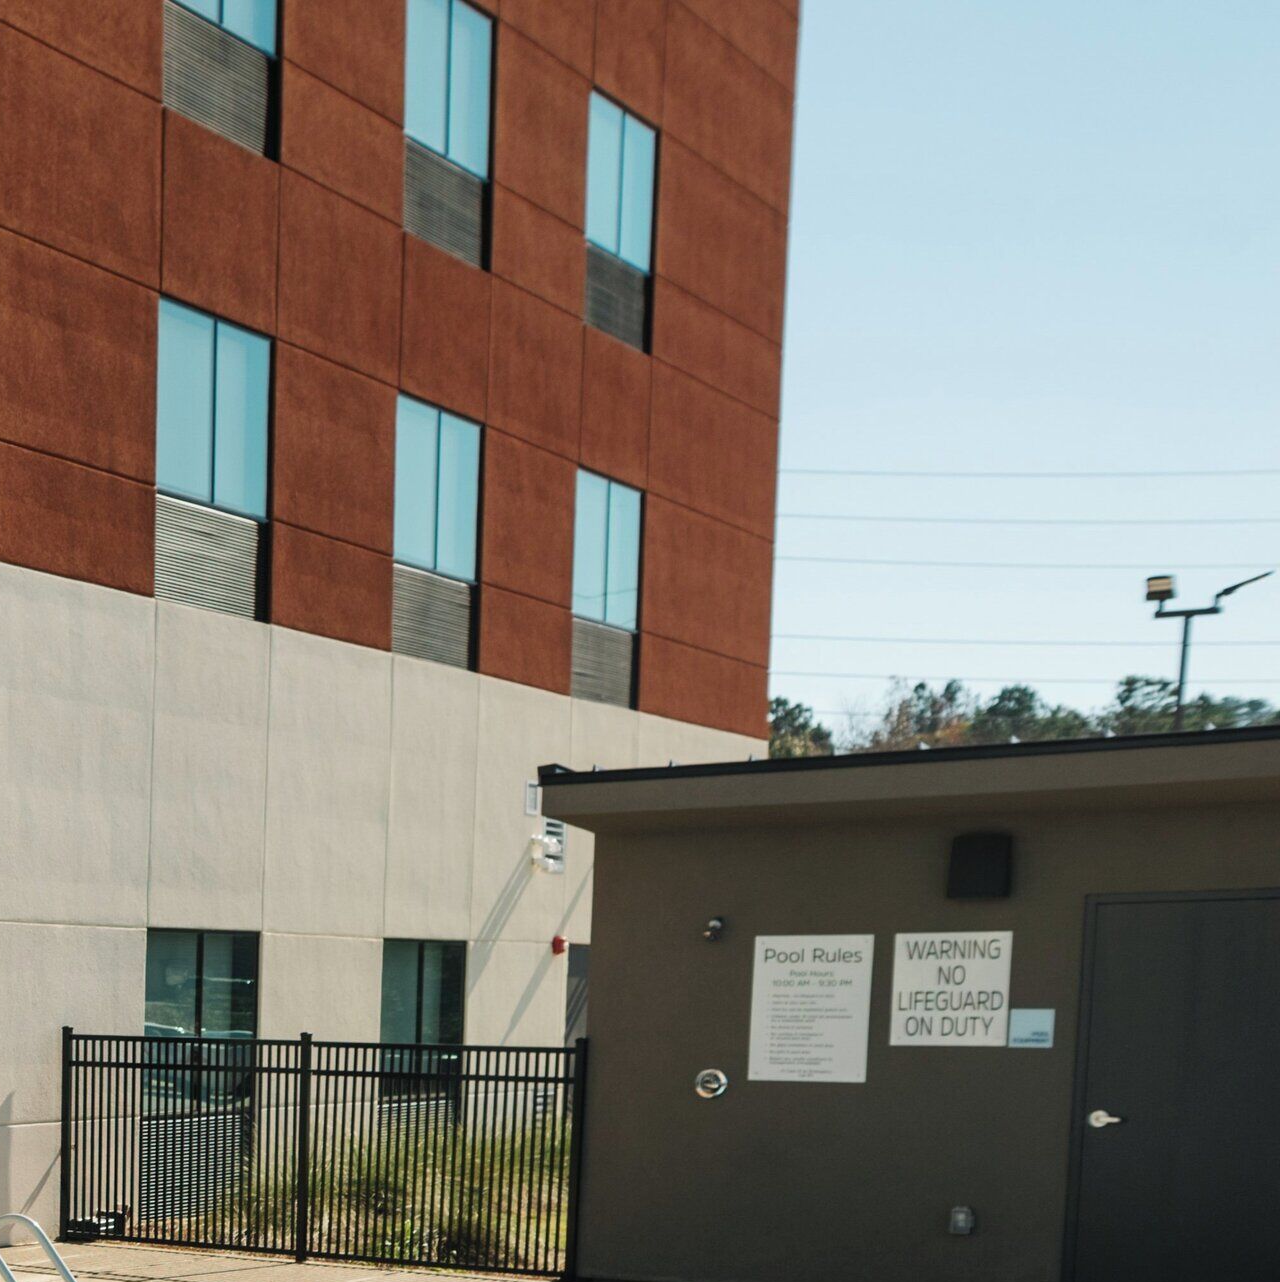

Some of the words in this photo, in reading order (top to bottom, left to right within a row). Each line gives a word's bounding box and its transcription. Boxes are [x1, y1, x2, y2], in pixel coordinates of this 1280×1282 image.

[764, 948, 805, 963] Pool
[812, 947, 863, 963] Rules
[906, 939, 1001, 960] WARNING
[937, 965, 966, 985] NO
[898, 990, 1004, 1011] LIFEGUARD
[905, 1016, 933, 1036] ON
[940, 1016, 994, 1036] DUTY
